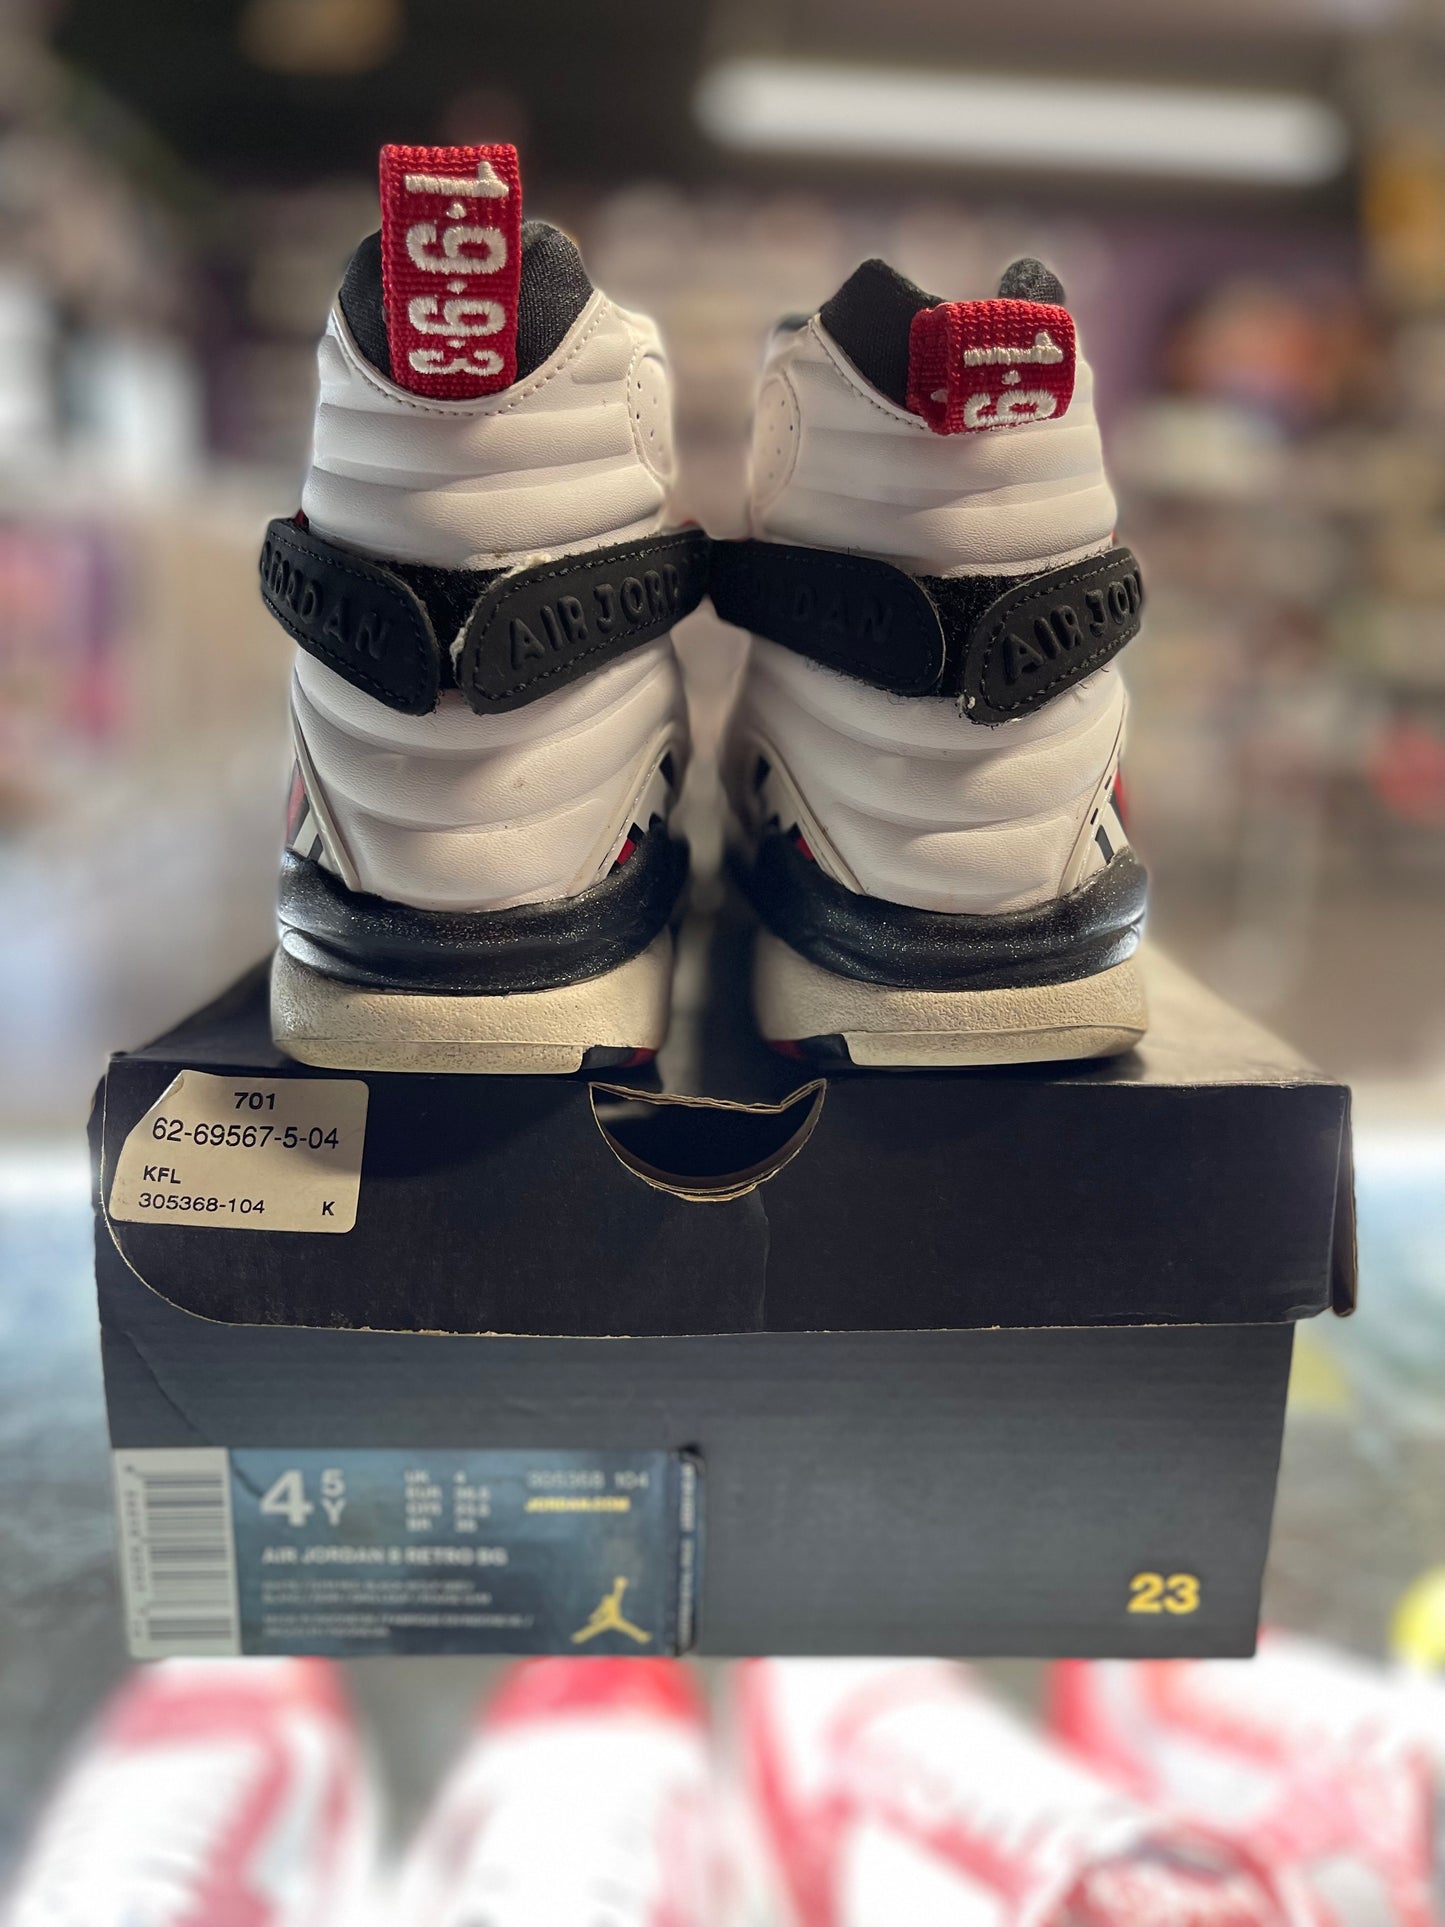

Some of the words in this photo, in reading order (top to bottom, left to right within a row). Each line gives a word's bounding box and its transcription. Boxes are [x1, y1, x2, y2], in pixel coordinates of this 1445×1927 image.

[509, 595, 588, 670] AIR
[1002, 605, 1083, 686] AIR
[234, 1092, 276, 1110] 701
[152, 1116, 339, 1150] 62-69567-5-04
[143, 1164, 182, 1184] KFL
[138, 1192, 265, 1214] 305368-104
[321, 1200, 335, 1216] K
[260, 1468, 316, 1528] 4
[321, 1468, 346, 1498] 5
[320, 1498, 347, 1527] Y
[261, 1546, 298, 1565] AIR
[301, 1546, 385, 1565] JORDAN
[404, 1546, 474, 1567] RETRO
[1127, 1571, 1200, 1615] 23
